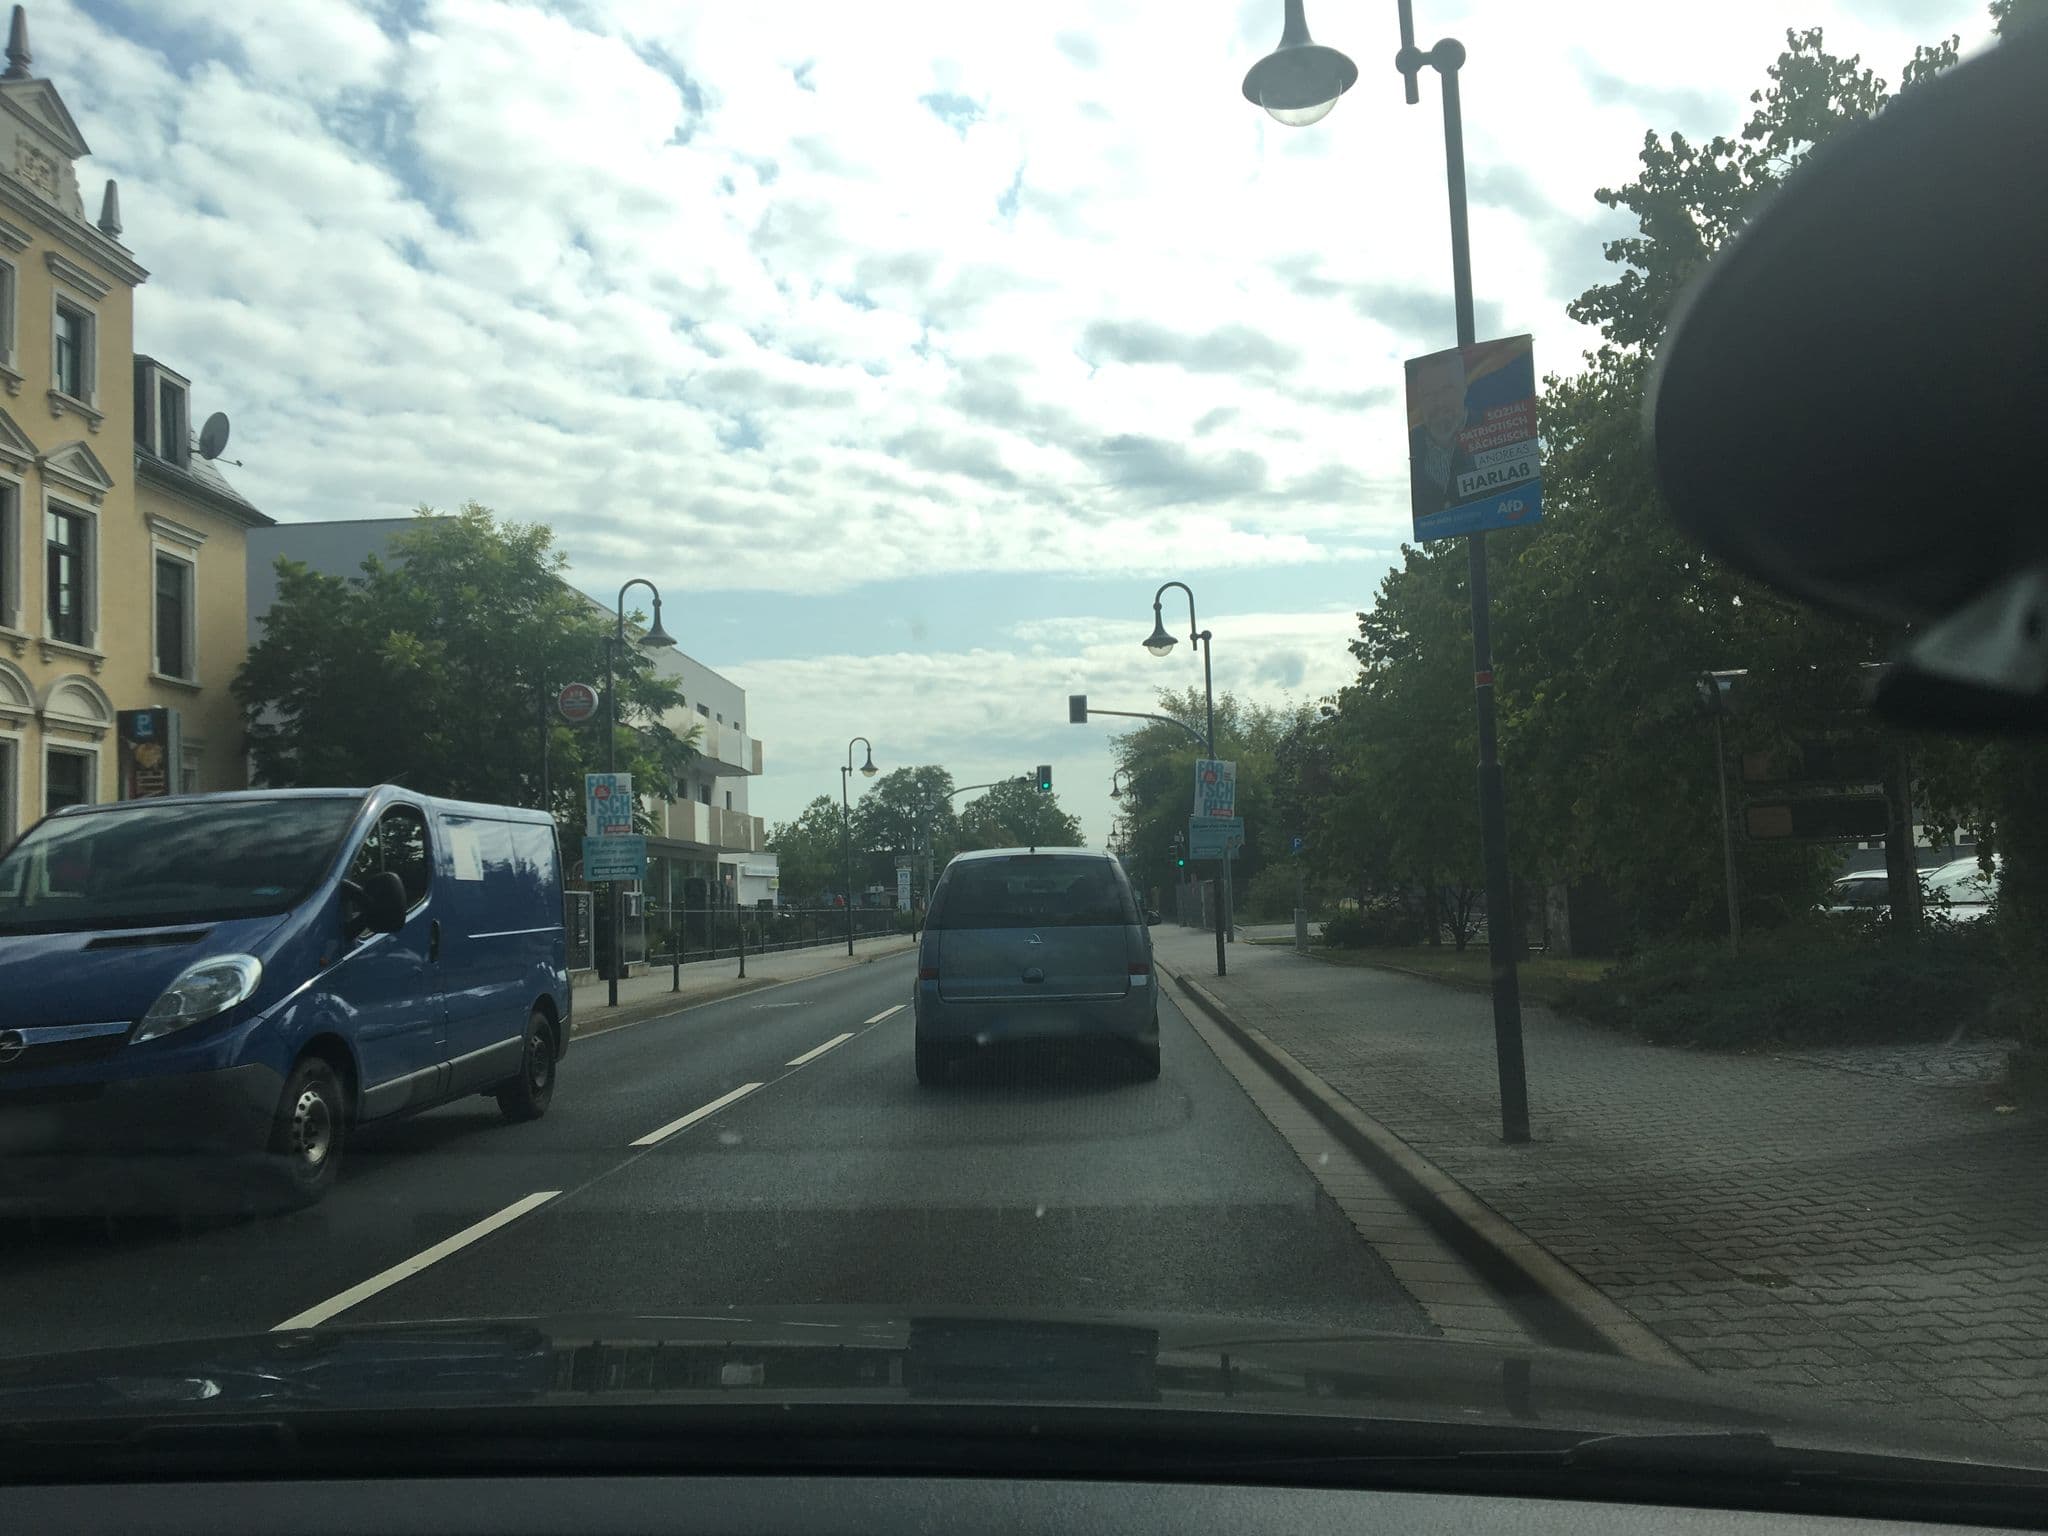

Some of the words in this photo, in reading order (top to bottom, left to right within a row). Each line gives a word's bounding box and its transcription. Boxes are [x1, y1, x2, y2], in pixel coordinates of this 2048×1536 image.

[1487, 403, 1528, 421] SOZIAL
[1460, 416, 1528, 441] PATRIOTISCH
[1479, 444, 1530, 465] ANDREAS
[1497, 500, 1524, 514] AfD
